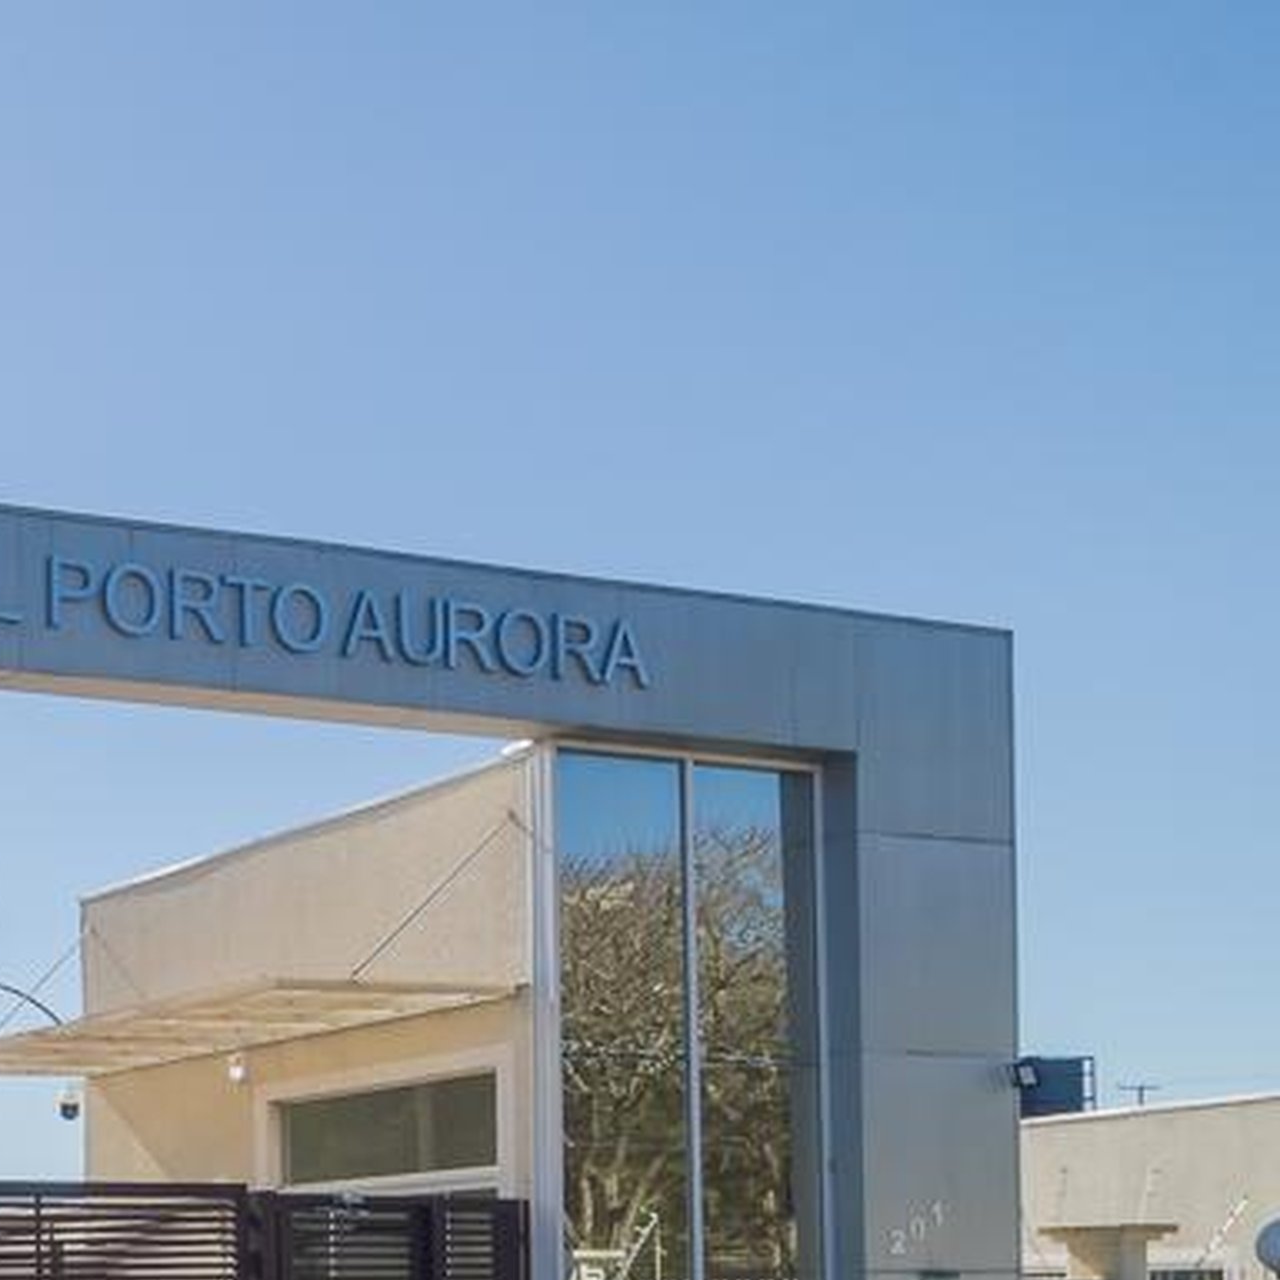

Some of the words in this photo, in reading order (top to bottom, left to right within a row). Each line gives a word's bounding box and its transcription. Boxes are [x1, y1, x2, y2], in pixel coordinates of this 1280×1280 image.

[44, 553, 326, 655] PORTO
[340, 590, 650, 690] AURORA
[890, 1200, 944, 1255] 201
